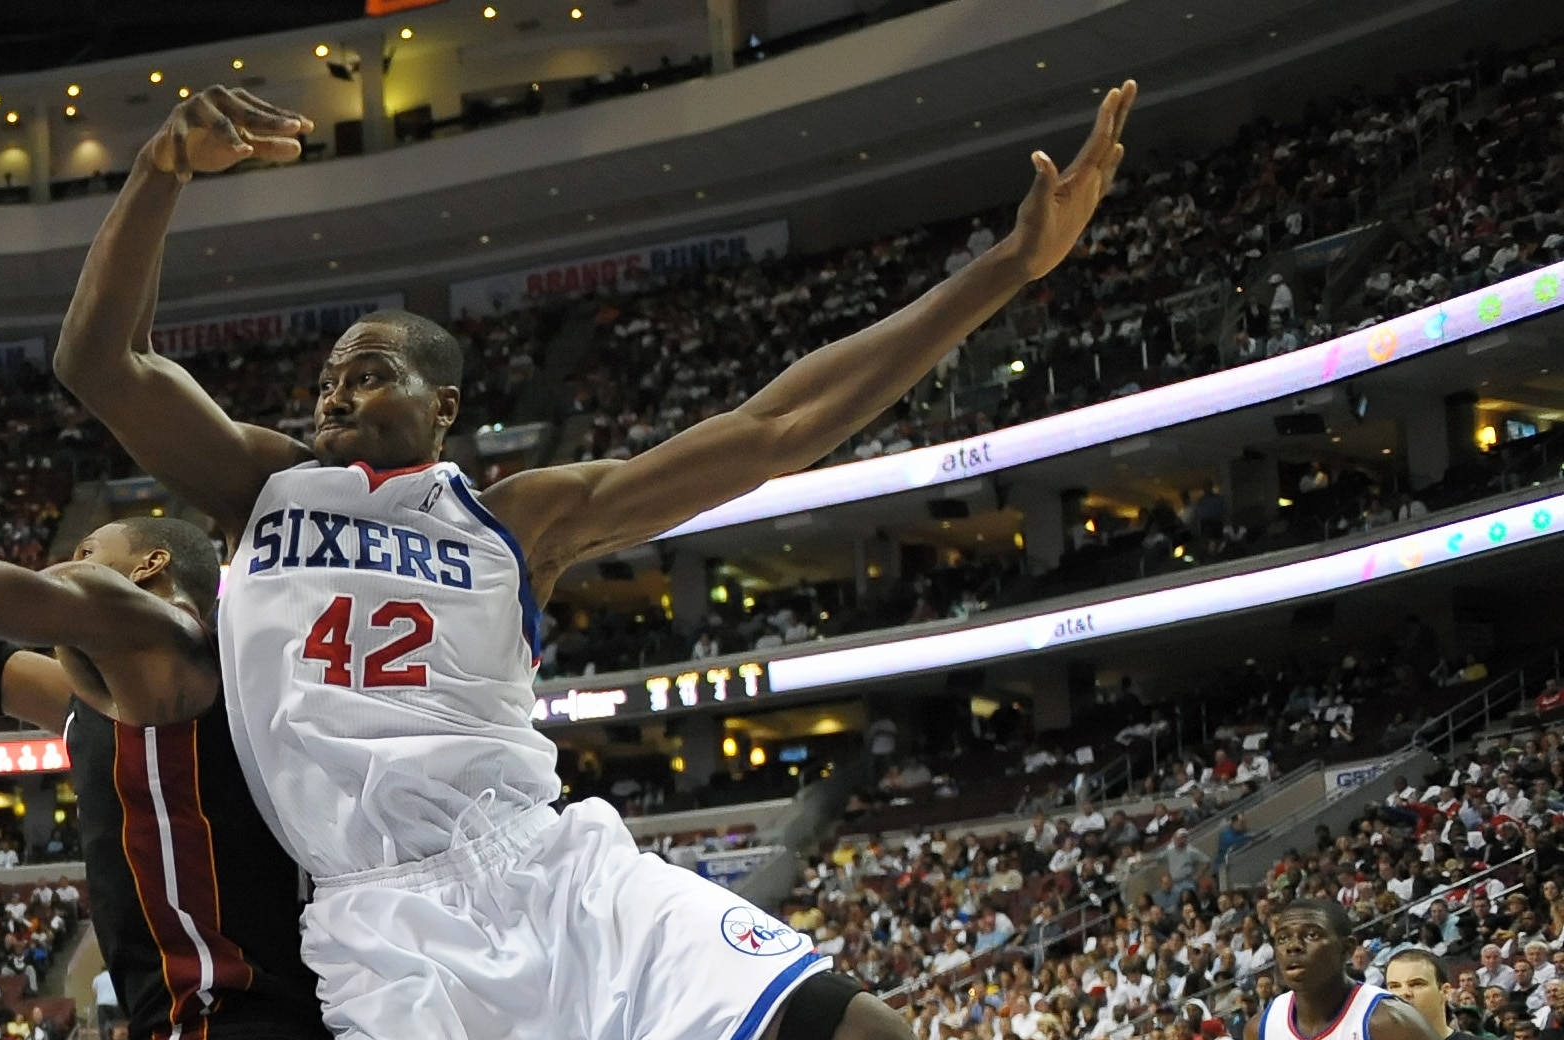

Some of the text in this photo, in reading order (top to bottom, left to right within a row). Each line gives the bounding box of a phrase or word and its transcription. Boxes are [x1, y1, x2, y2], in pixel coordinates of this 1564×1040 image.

[941, 442, 992, 472] at&t
[248, 506, 473, 590] SIXERS
[301, 593, 437, 689] 42
[1053, 613, 1095, 638] at&t
